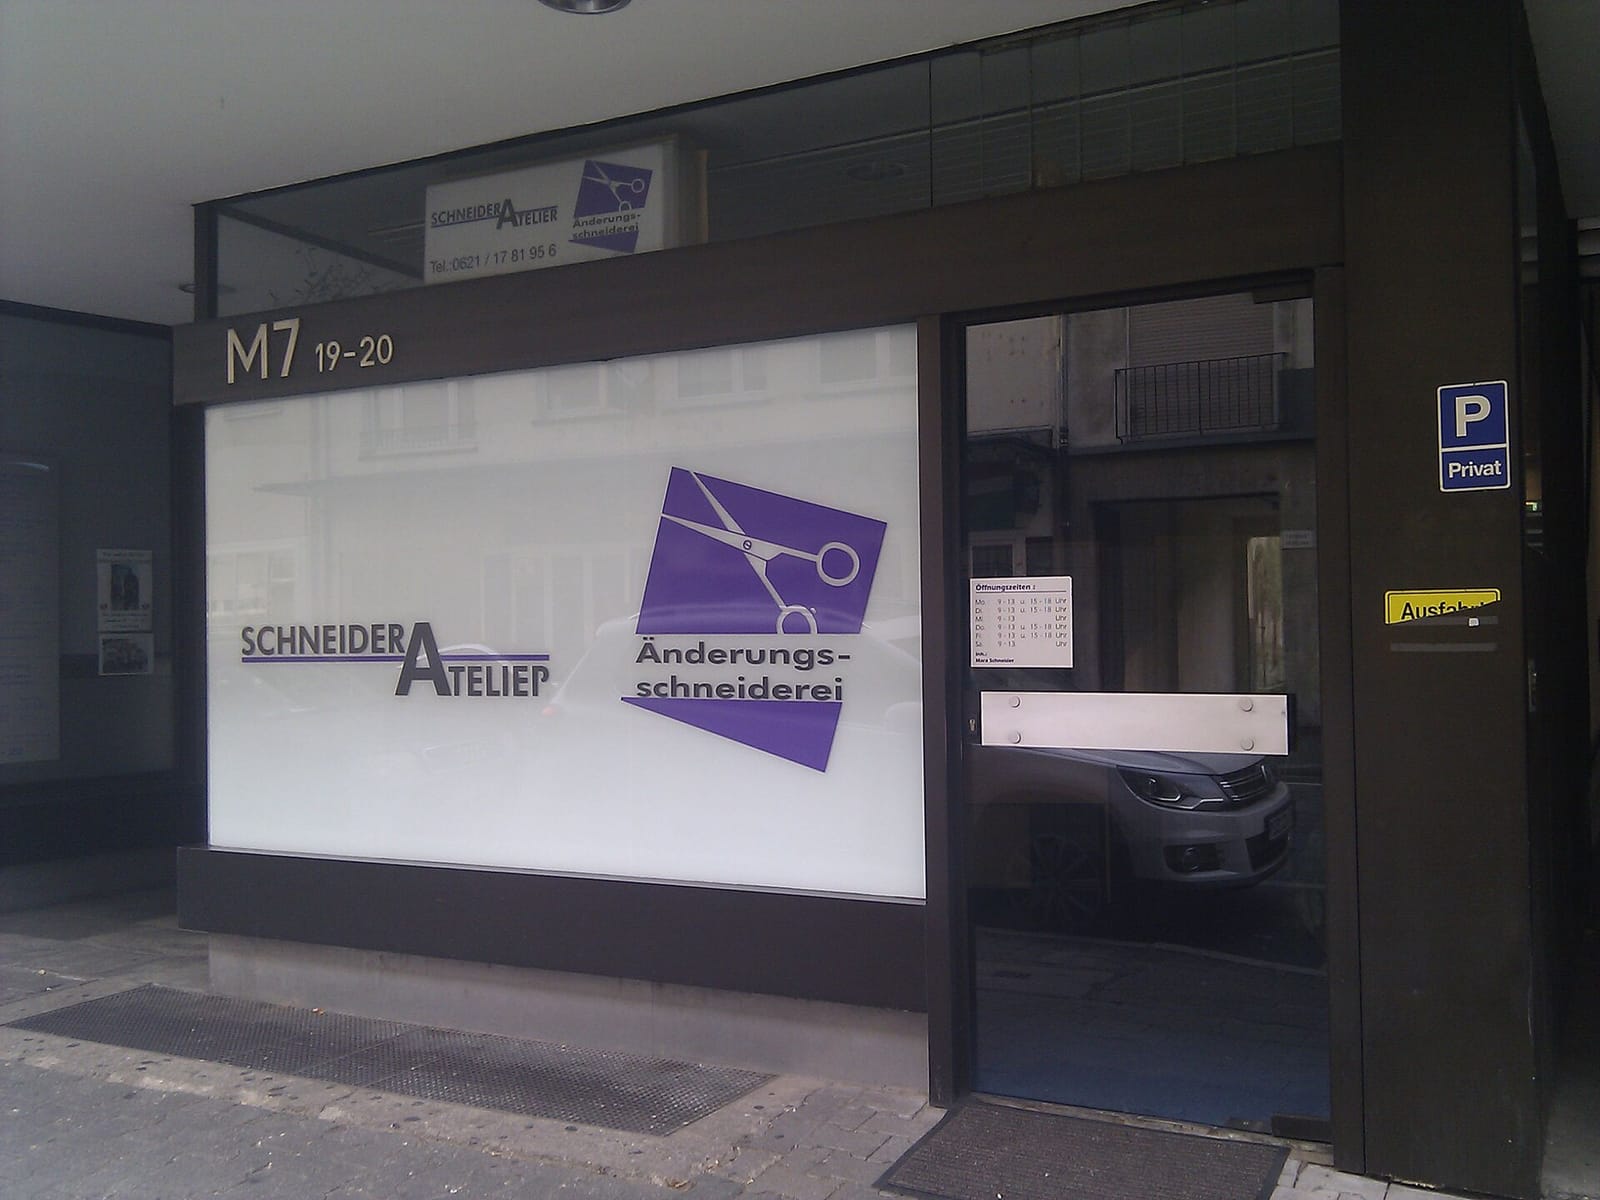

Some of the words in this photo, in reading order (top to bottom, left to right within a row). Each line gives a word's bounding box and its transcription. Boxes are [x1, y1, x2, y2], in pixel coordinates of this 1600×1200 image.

[431, 202, 500, 226] SCHNEIDER
[496, 199, 559, 230] ATELIER
[572, 222, 639, 240] schneiderei
[494, 250, 507, 265] 17
[511, 248, 525, 263] 81
[529, 245, 545, 261] 95
[548, 243, 557, 257] 6
[227, 317, 300, 385] M7
[315, 333, 393, 373] 19-20
[1455, 395, 1491, 437] P
[1448, 461, 1502, 478] Privat
[975, 584, 1031, 592] Öffnungszeiten
[1401, 601, 1486, 620] Ausf
[241, 623, 406, 655] SCHNEIDER
[635, 636, 851, 671] Änderungs-
[636, 675, 843, 700] schneiderei
